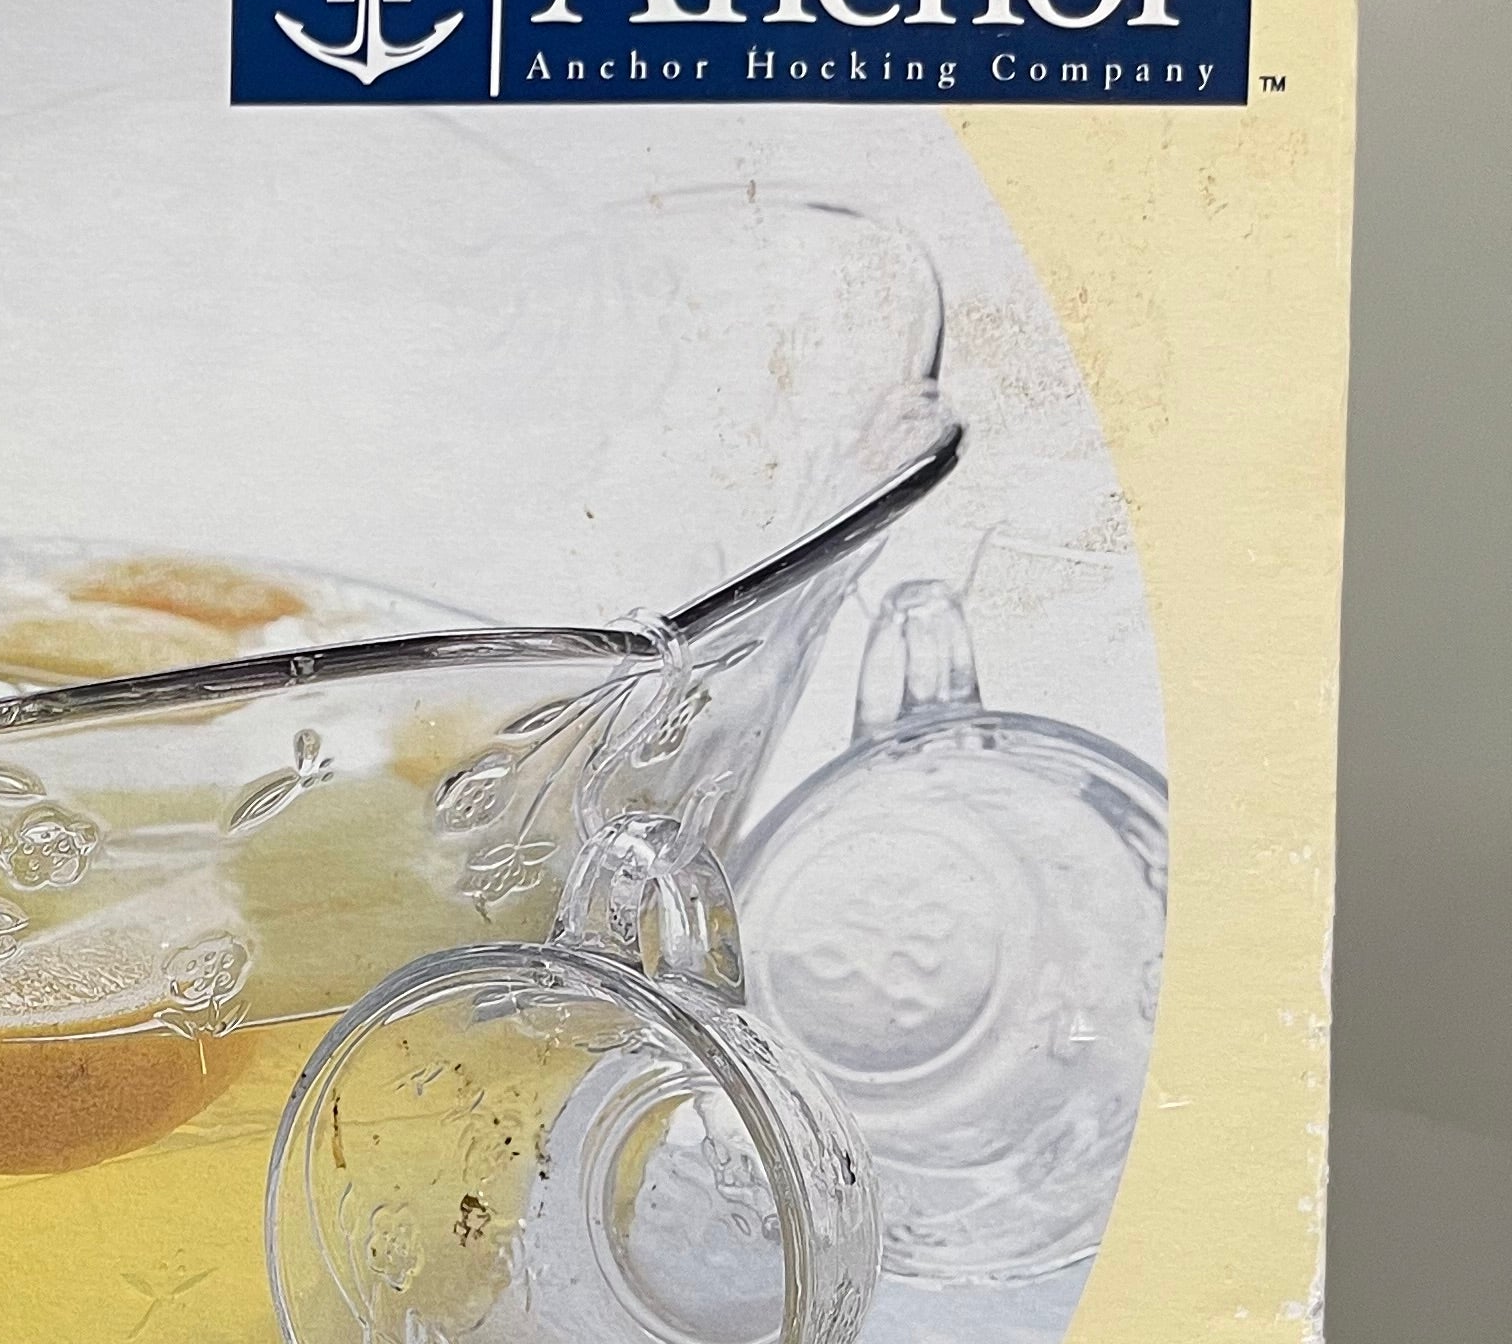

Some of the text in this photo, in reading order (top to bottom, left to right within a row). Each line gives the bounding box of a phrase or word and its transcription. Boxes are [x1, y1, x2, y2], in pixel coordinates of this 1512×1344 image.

[525, 50, 709, 81] Anchor
[745, 49, 957, 89] Hocking
[991, 53, 1216, 91] Company
